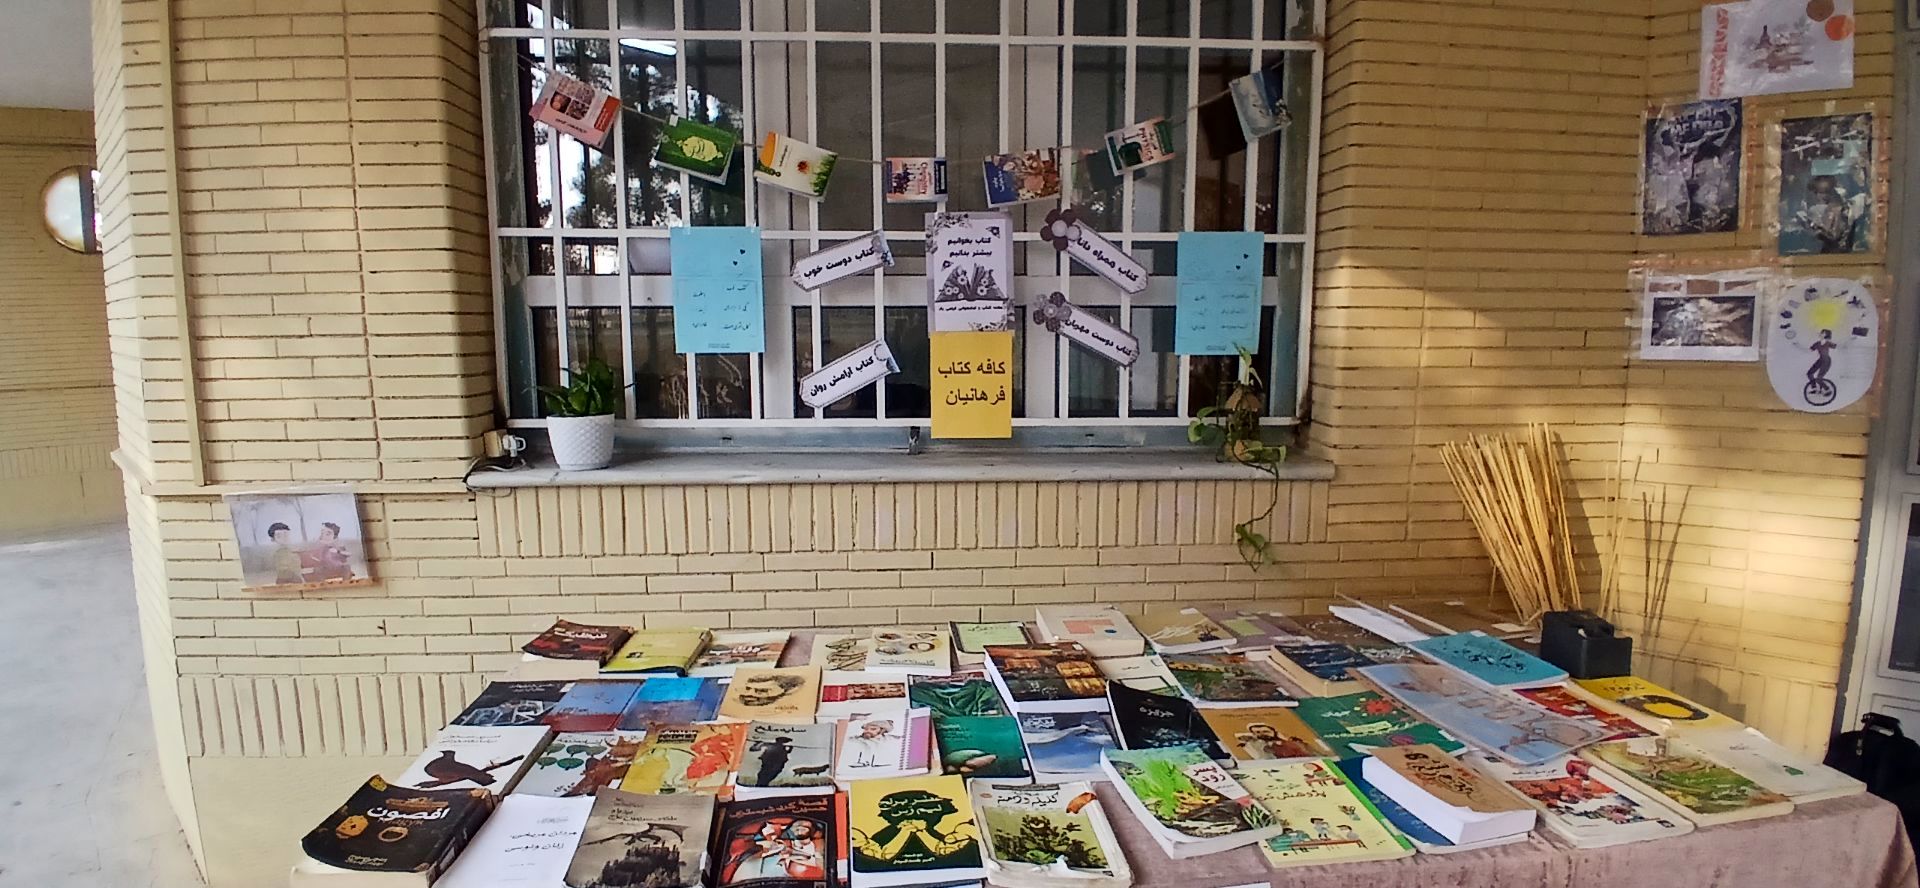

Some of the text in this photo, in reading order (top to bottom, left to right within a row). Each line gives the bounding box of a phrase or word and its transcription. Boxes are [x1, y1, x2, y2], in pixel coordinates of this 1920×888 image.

[975, 237, 992, 245] کتاب
[804, 247, 875, 279] کتاب دوست خوب
[1092, 249, 1117, 269] همراه
[1118, 266, 1140, 282] کتاب
[1064, 319, 1133, 356] کتاب دوست مهربان
[855, 356, 874, 372] کتاب
[937, 359, 1006, 378] کافه کتاب
[810, 383, 827, 397] روان
[1031, 791, 1059, 808] کلیله
